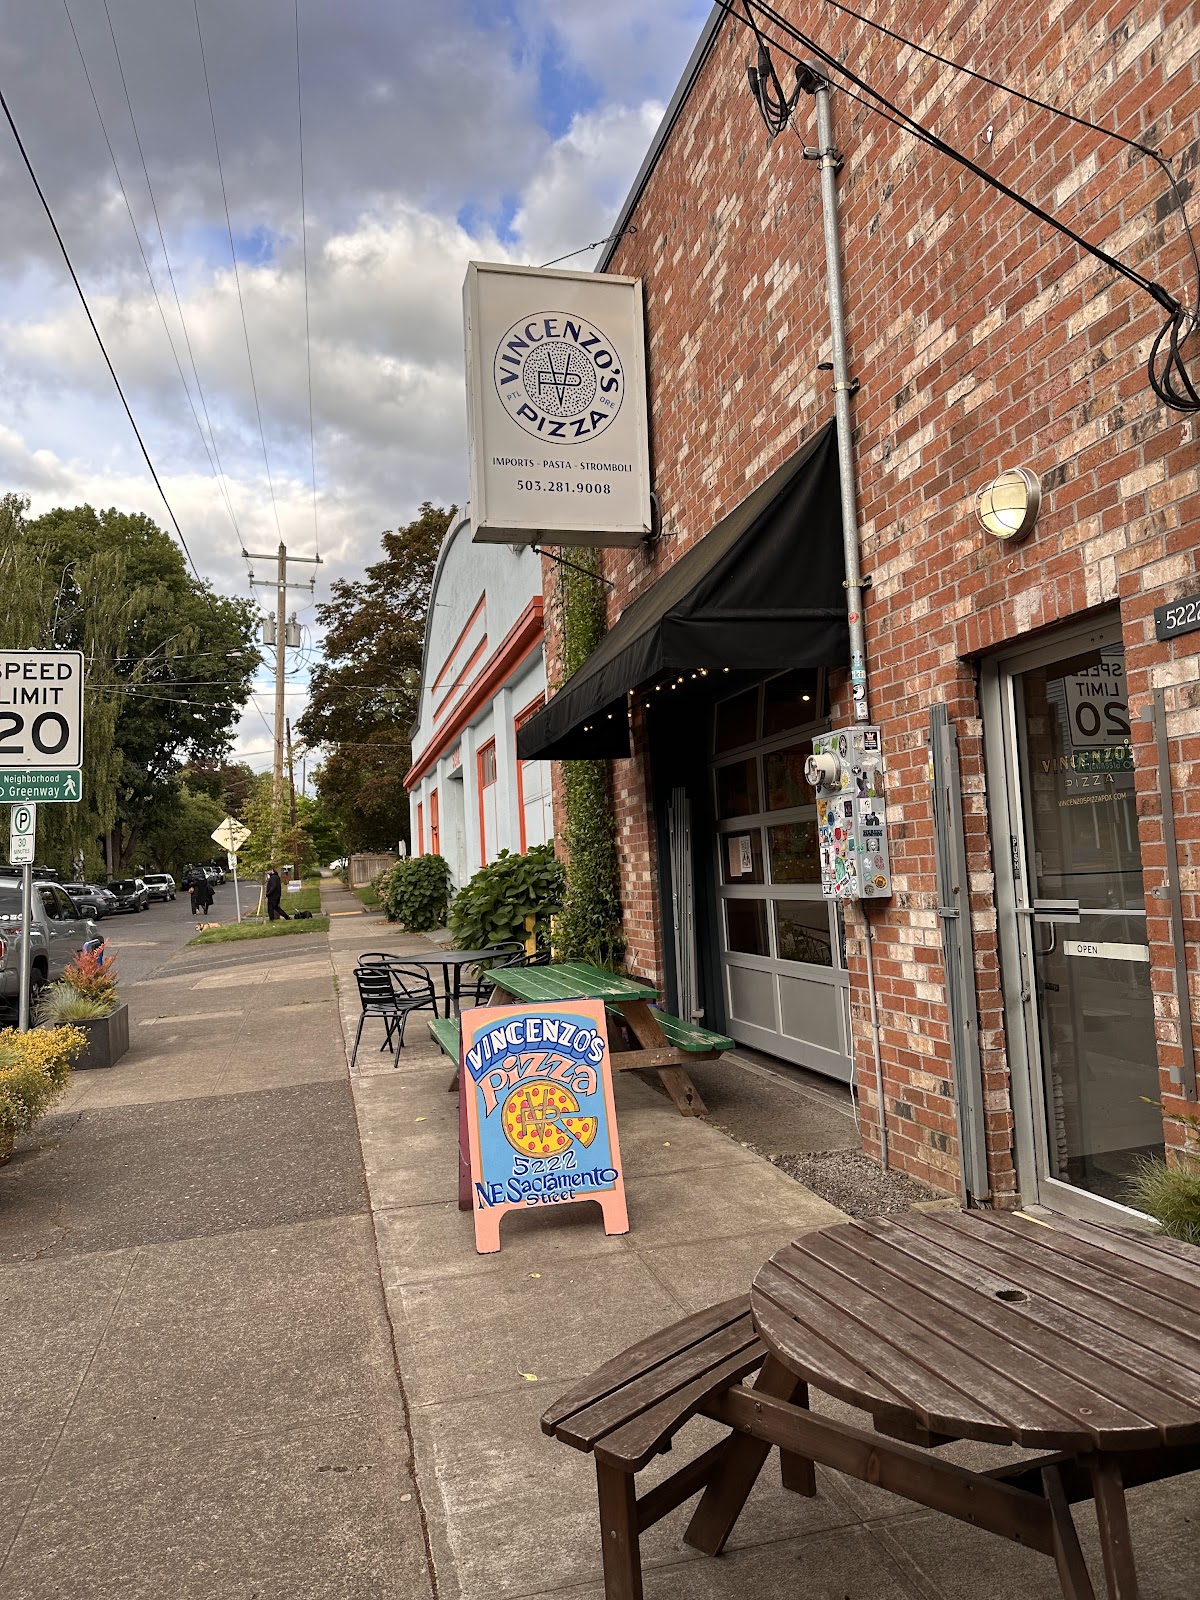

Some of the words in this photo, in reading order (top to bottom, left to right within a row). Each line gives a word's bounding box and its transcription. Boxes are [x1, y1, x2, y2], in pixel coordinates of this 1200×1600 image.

[499, 318, 621, 393] VINCENZO'S
[507, 390, 522, 401] PTL
[599, 396, 616, 409] ORE
[516, 402, 609, 438] PIZZA
[492, 457, 534, 467] IMPORTS
[543, 460, 572, 469] PASTA
[580, 462, 632, 472] STROMBOLI
[517, 480, 611, 494] 503.281.9008
[0, 663, 72, 680] PEED
[0, 711, 70, 755] 20
[3, 774, 60, 785] Neighborhood
[1065, 773, 1114, 788] PIZZA
[8, 786, 60, 799] Greenway
[19, 812, 28, 829] P
[17, 838, 27, 848] 30
[1012, 838, 1020, 870] PUSH
[1076, 944, 1098, 954] OPEN
[466, 1018, 605, 1076] VINCENZO'S
[513, 1150, 577, 1176] 5222
[475, 1181, 506, 1210] NE
[506, 1167, 619, 1203] Sacramento
[526, 1189, 576, 1206] Street
